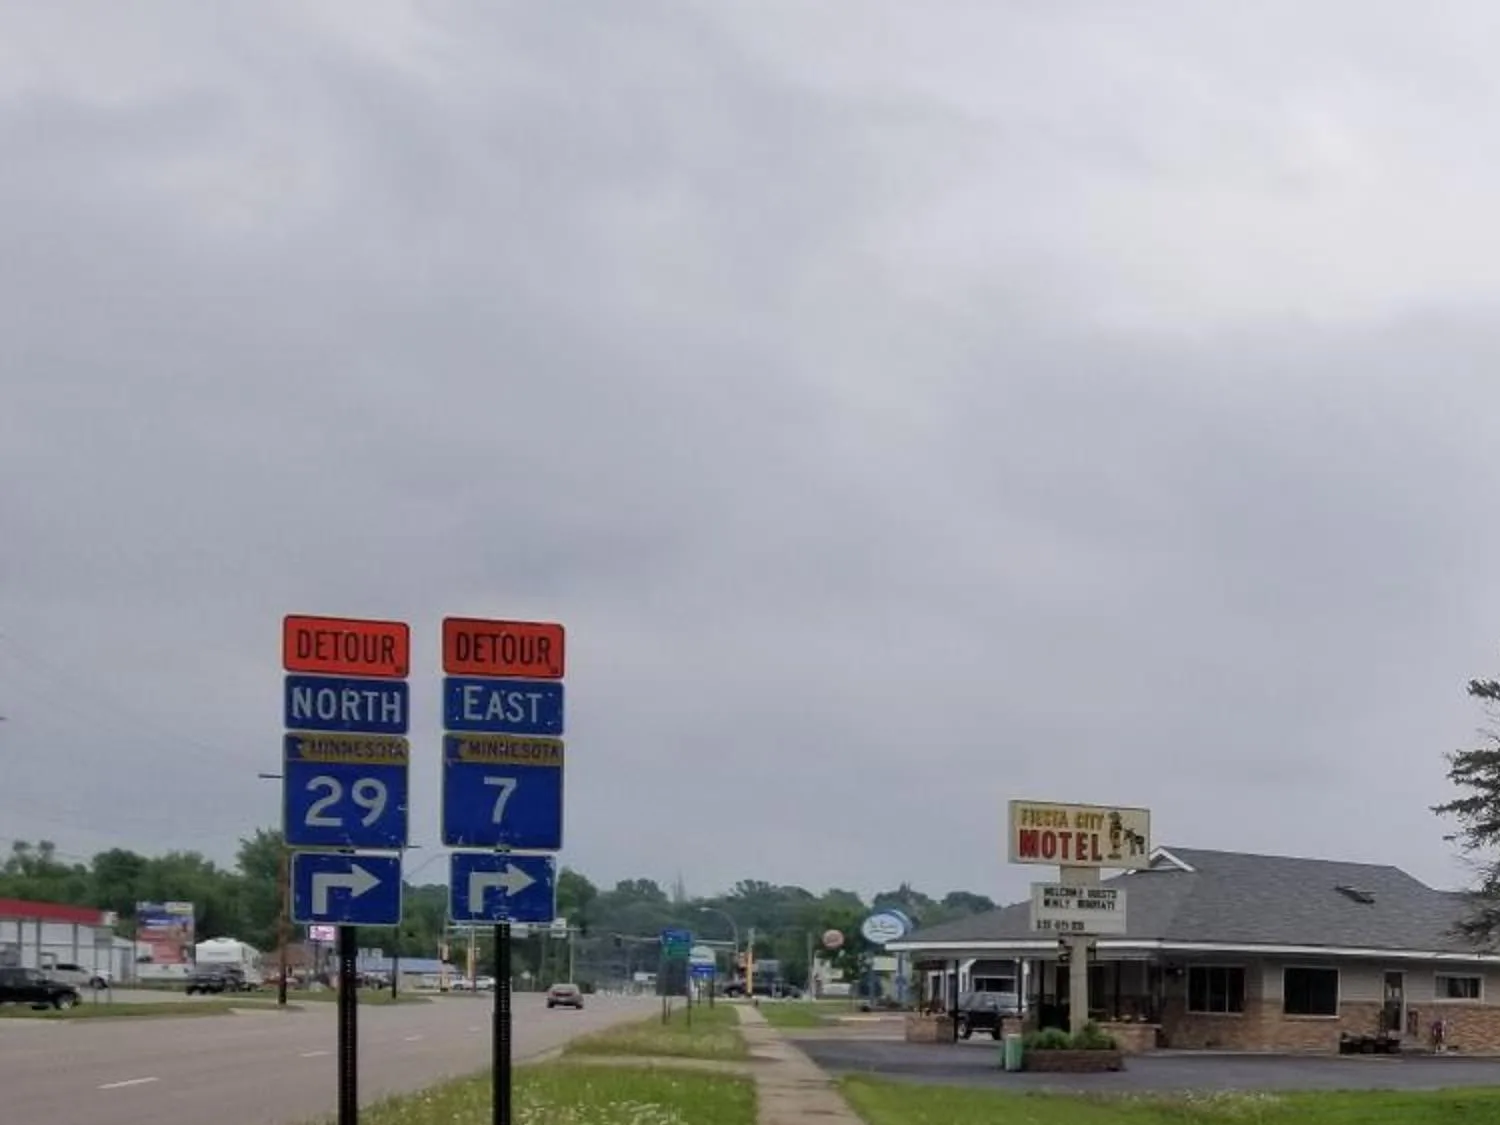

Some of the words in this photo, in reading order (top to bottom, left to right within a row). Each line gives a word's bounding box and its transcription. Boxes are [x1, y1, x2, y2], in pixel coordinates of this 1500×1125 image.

[295, 629, 395, 665] DETOUR
[455, 631, 551, 663] DETOUR
[291, 687, 401, 723] NORTH
[463, 685, 543, 723] EAST
[468, 740, 559, 759] MINNESOTA
[304, 775, 388, 828] 29
[483, 776, 518, 824] 7
[1020, 808, 1068, 828] FIESTA
[1075, 811, 1105, 831] CITY
[1019, 829, 1103, 862] MOTEL
